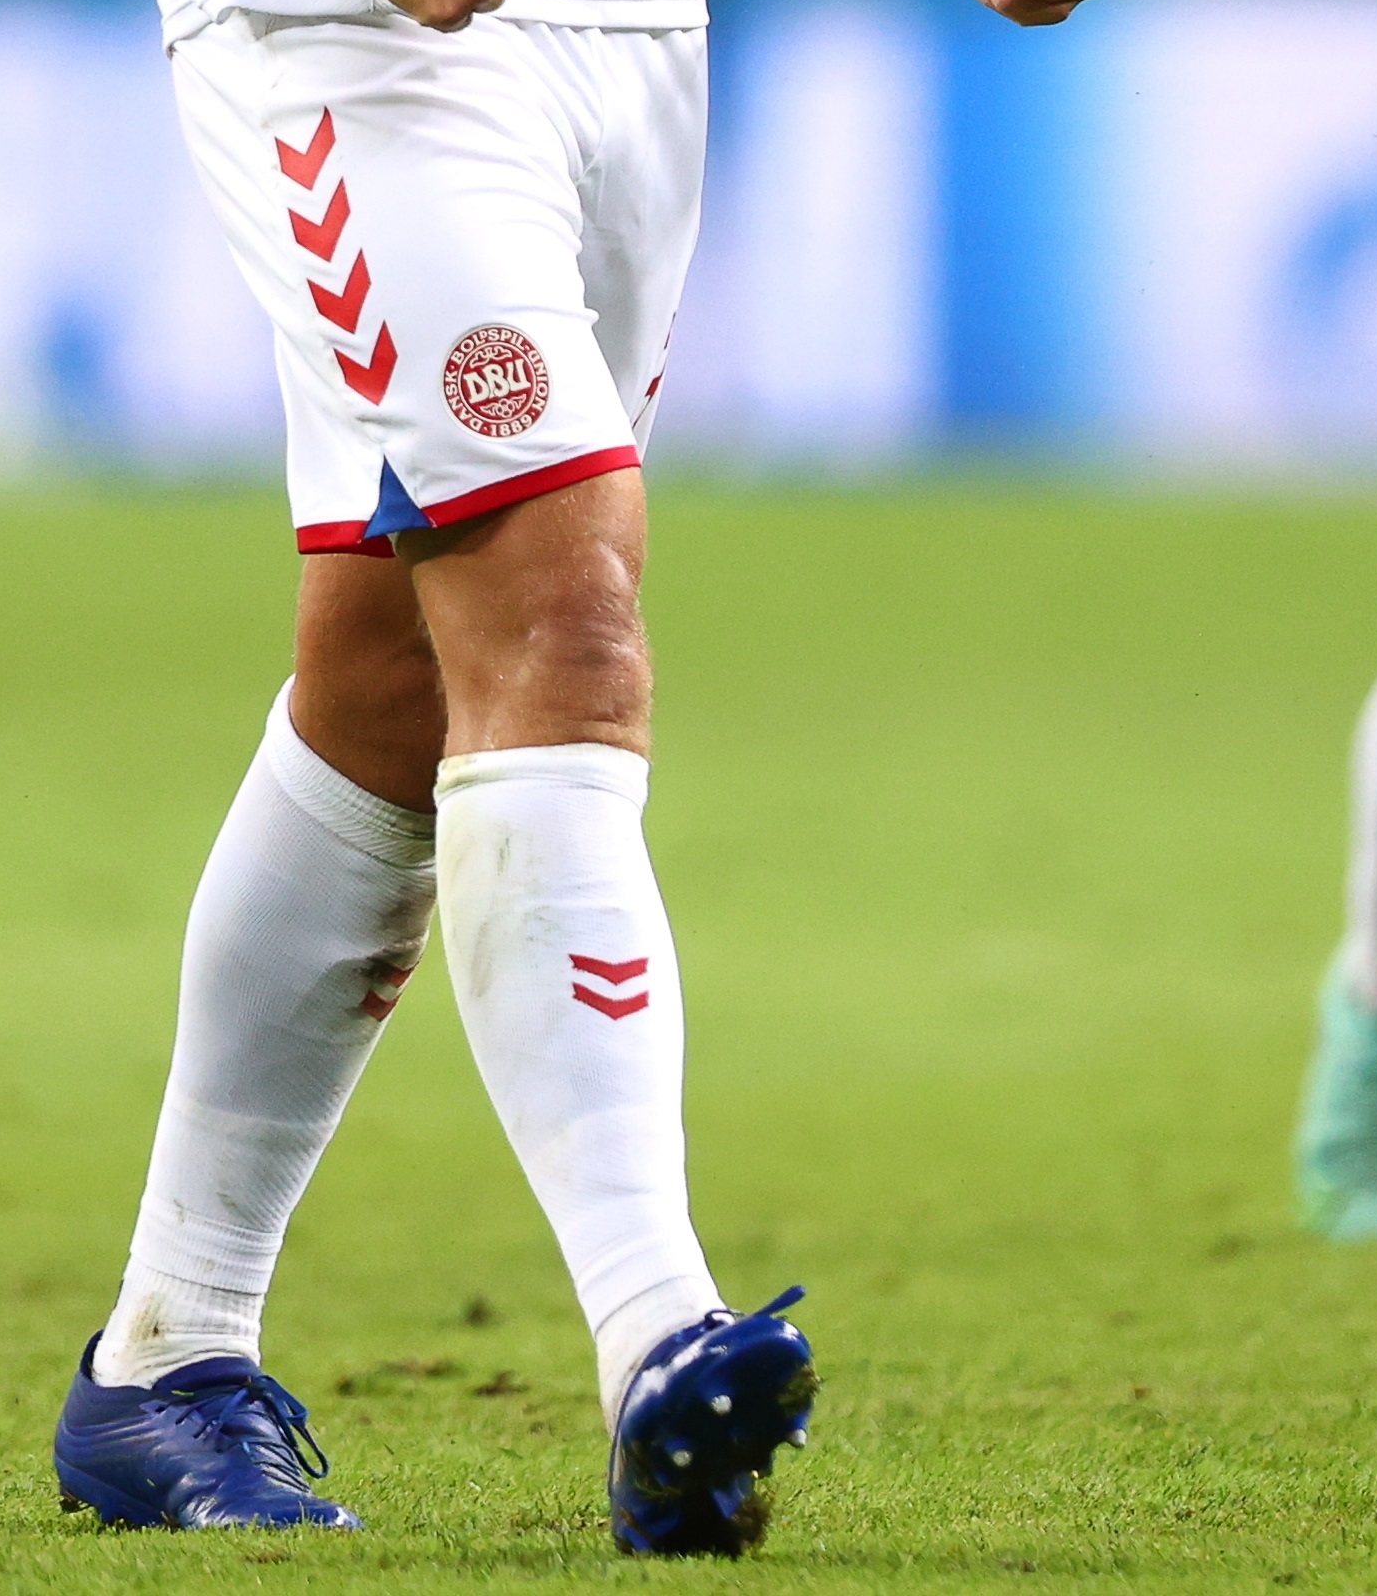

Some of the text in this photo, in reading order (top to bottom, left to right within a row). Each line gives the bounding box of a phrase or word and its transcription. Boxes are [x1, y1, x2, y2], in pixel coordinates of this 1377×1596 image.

[444, 370, 484, 432] DANSK
[462, 358, 532, 405] DBU
[489, 414, 533, 437] 1889
